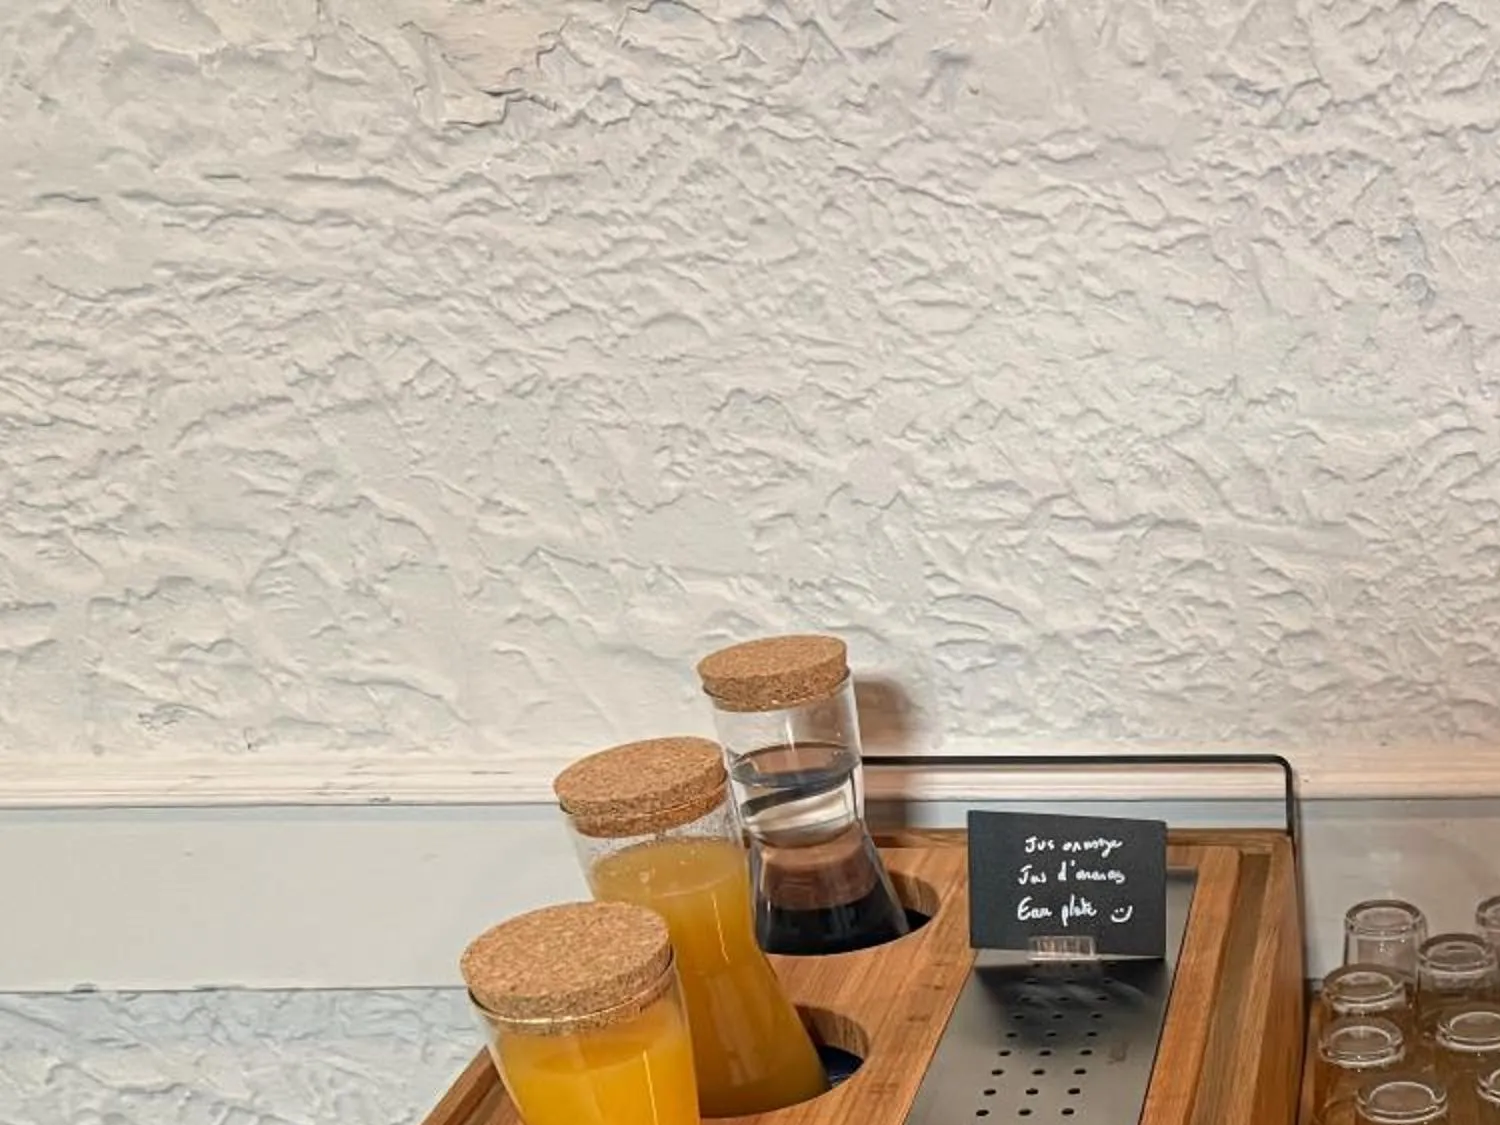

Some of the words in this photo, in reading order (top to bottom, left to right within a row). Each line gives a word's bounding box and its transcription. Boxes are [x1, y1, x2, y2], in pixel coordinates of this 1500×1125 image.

[1024, 835, 1056, 853] Jus
[1017, 863, 1047, 885] Jus
[1017, 896, 1053, 921] Eau
